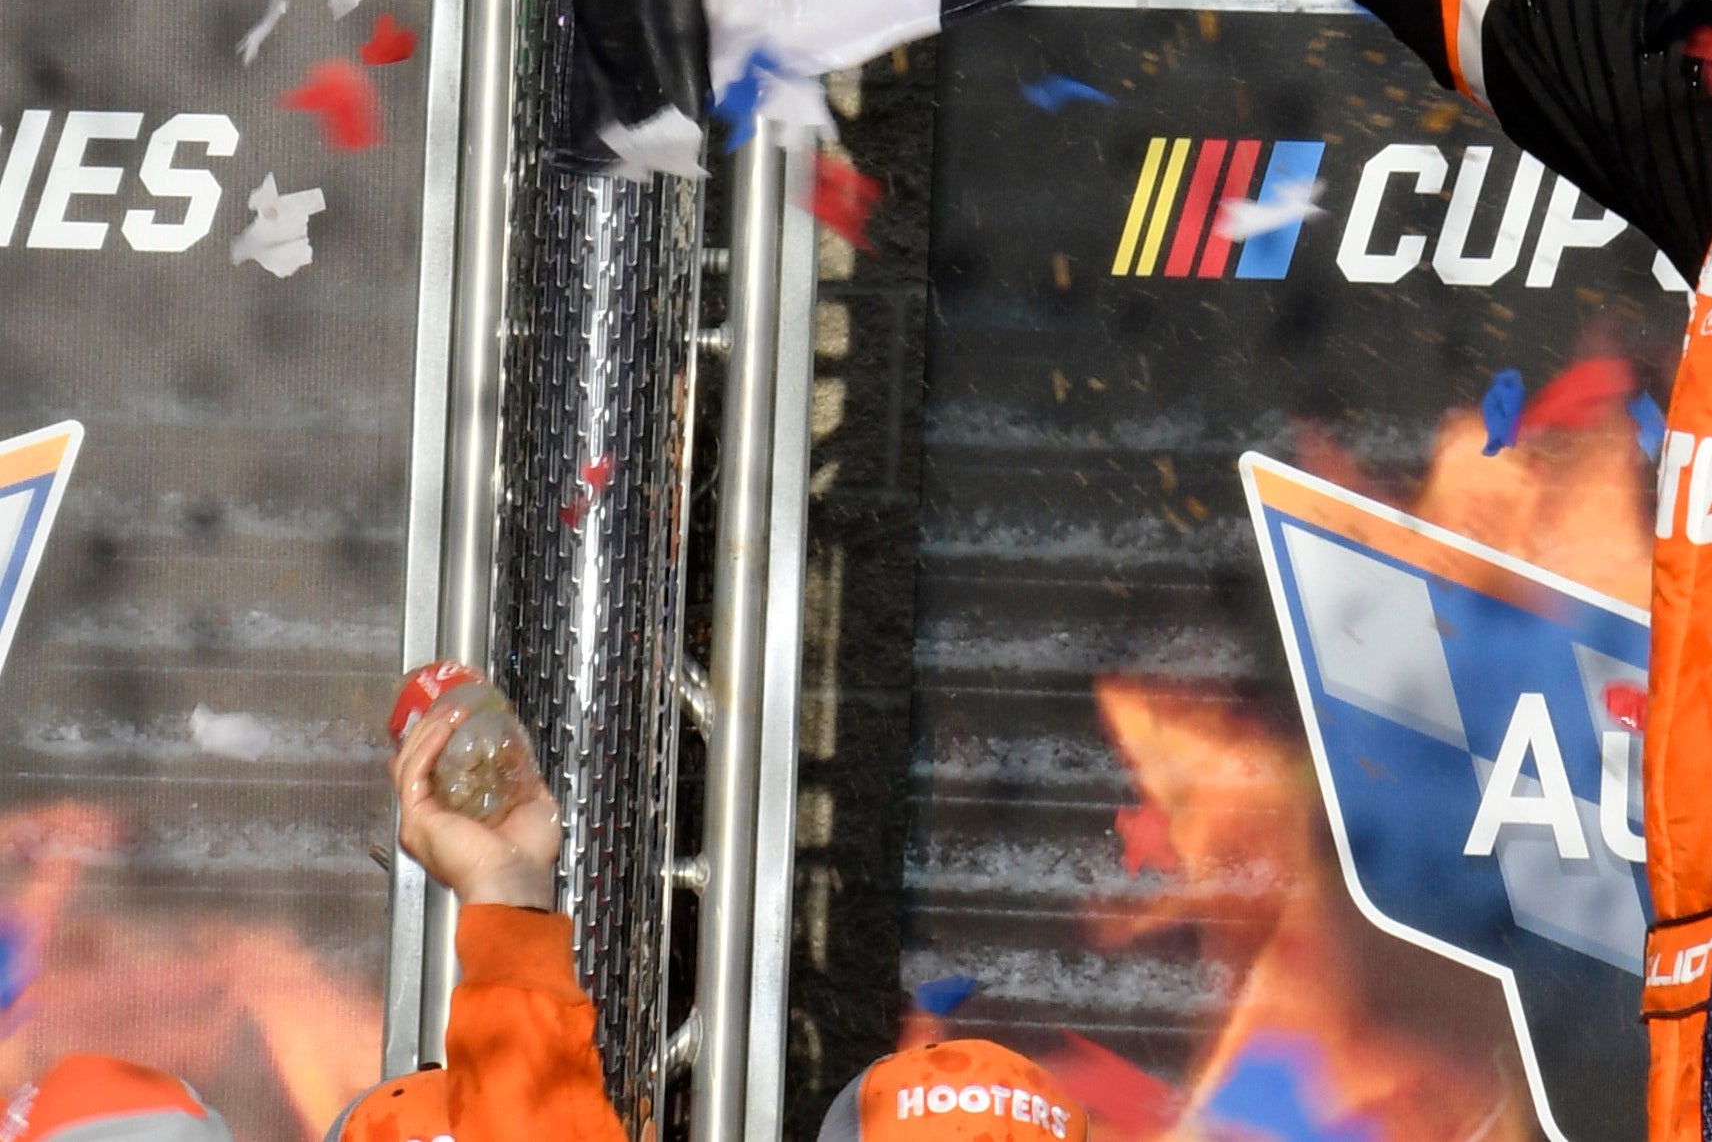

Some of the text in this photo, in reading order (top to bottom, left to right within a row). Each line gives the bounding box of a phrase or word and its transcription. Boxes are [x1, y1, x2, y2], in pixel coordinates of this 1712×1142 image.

[0, 110, 240, 252] IES
[1336, 143, 1629, 288] CUP
[896, 1084, 1071, 1140] HOOTERS
